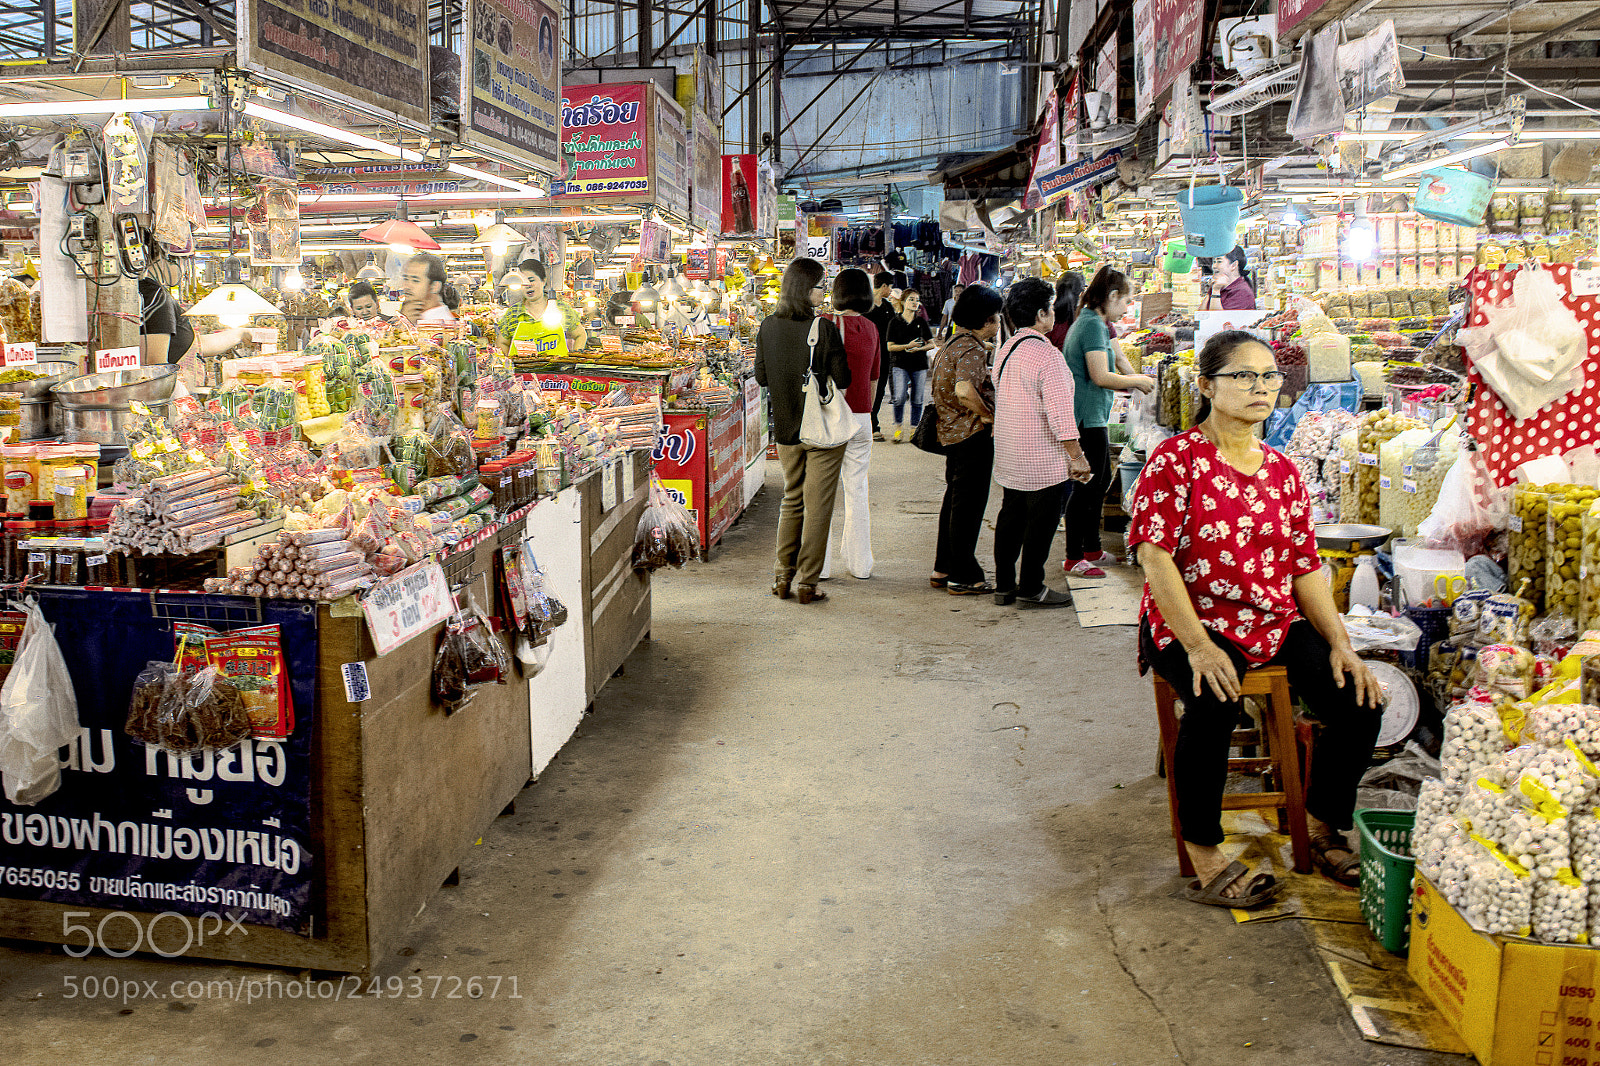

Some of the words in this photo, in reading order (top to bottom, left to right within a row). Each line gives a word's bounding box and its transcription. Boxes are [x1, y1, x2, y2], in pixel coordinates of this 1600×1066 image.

[564, 131, 643, 154] ทั้งปลีกและส่ง
[571, 152, 637, 171] ราคากันเอง
[567, 182, 583, 194] โทร.
[585, 180, 648, 193] 086-9247039
[98, 352, 137, 369] เผ็ดมาก
[1, 807, 301, 875] ของฝากเมืองเหนือ
[89, 873, 292, 917] ขายปลีกและส่งราคากันเอง
[1567, 1016, 1593, 1028] 350
[1564, 1037, 1590, 1049] 400
